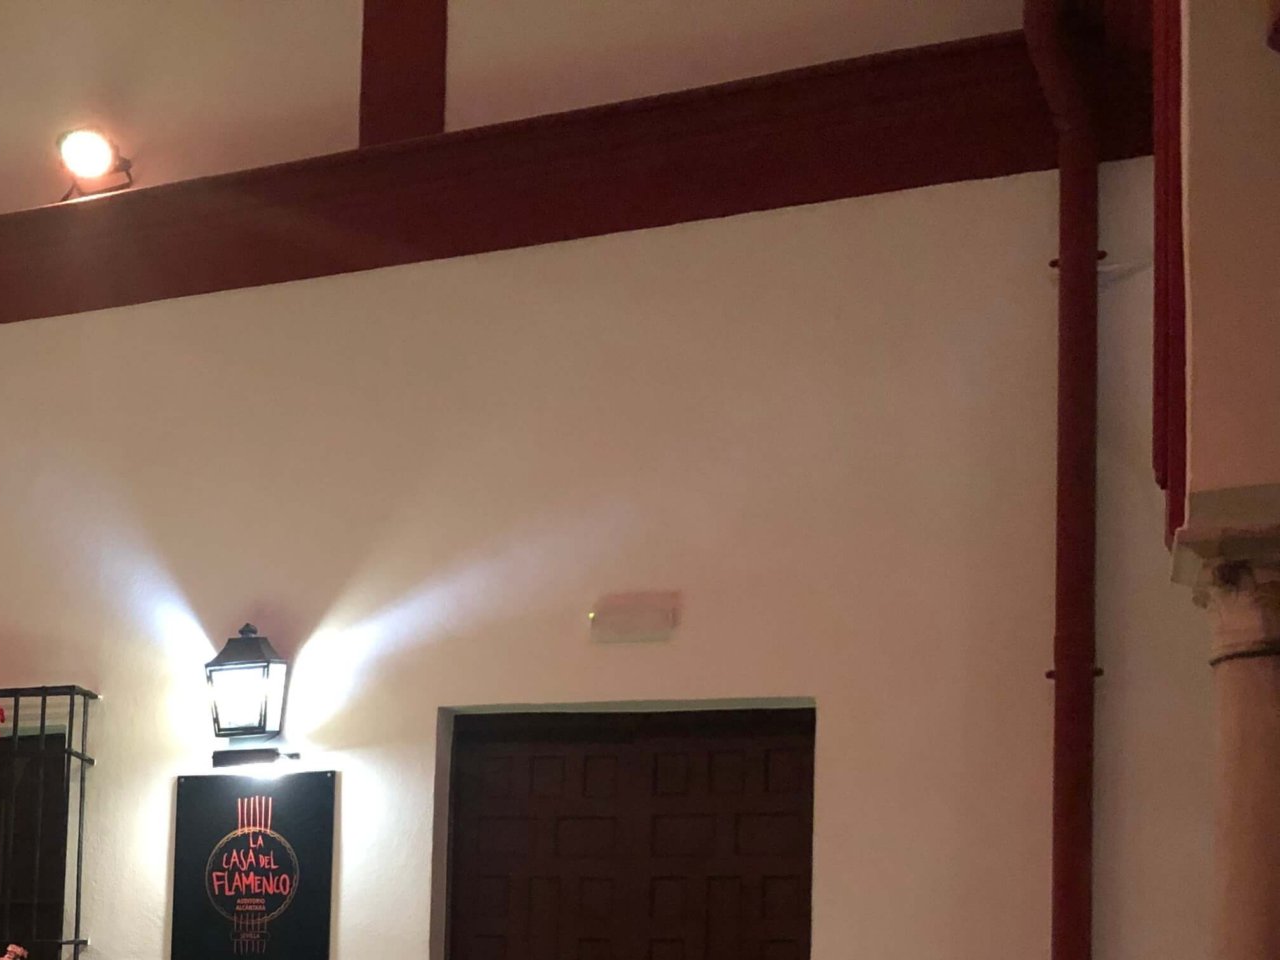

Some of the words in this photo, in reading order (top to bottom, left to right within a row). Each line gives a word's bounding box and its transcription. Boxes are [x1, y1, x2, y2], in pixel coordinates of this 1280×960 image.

[250, 831, 264, 848] LA
[222, 848, 256, 871] CASA
[259, 850, 279, 869] DEL
[212, 871, 290, 896] FLAMENCO
